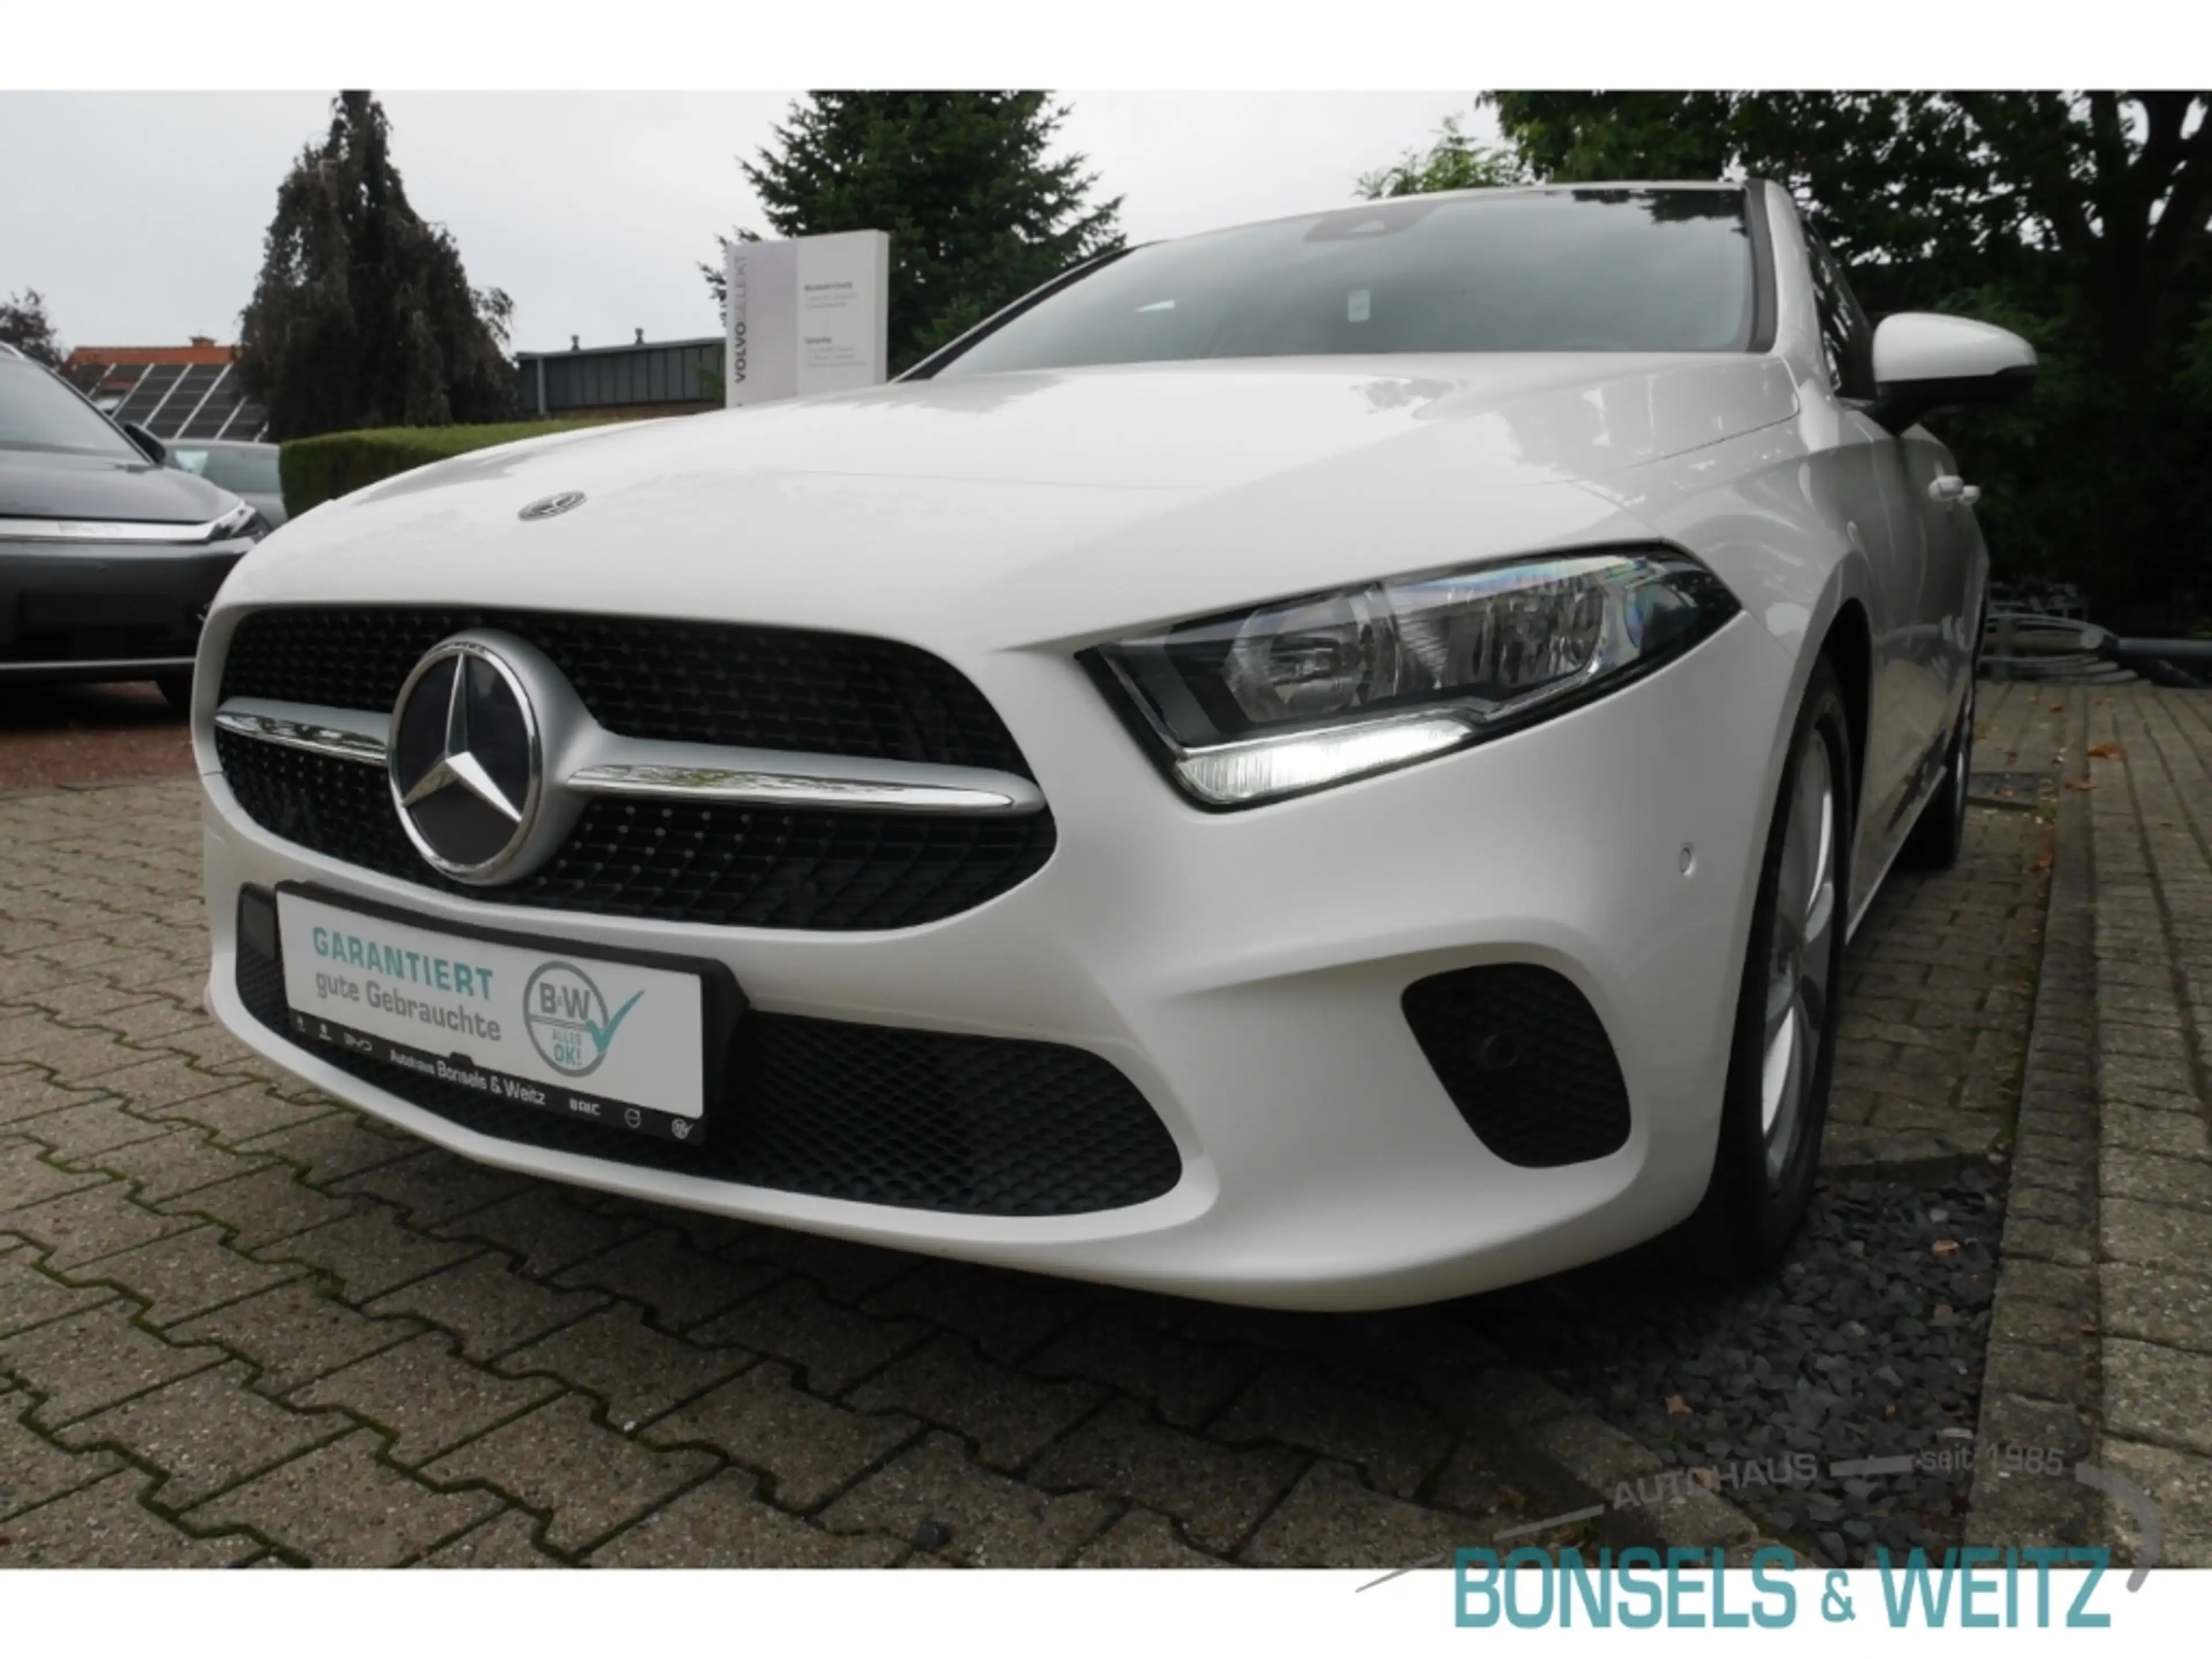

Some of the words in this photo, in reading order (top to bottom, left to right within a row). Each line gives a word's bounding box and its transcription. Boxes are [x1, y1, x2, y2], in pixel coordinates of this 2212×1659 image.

[734, 322, 747, 383] VOLVO
[312, 926, 494, 1001] GARANTIERT
[315, 972, 360, 1002] gute
[365, 980, 502, 1042] Gebrauchte
[436, 1059, 488, 1090] Bonsels
[490, 1075, 502, 1094] &
[503, 1077, 546, 1105] Weitz
[553, 1043, 582, 1066] OK!
